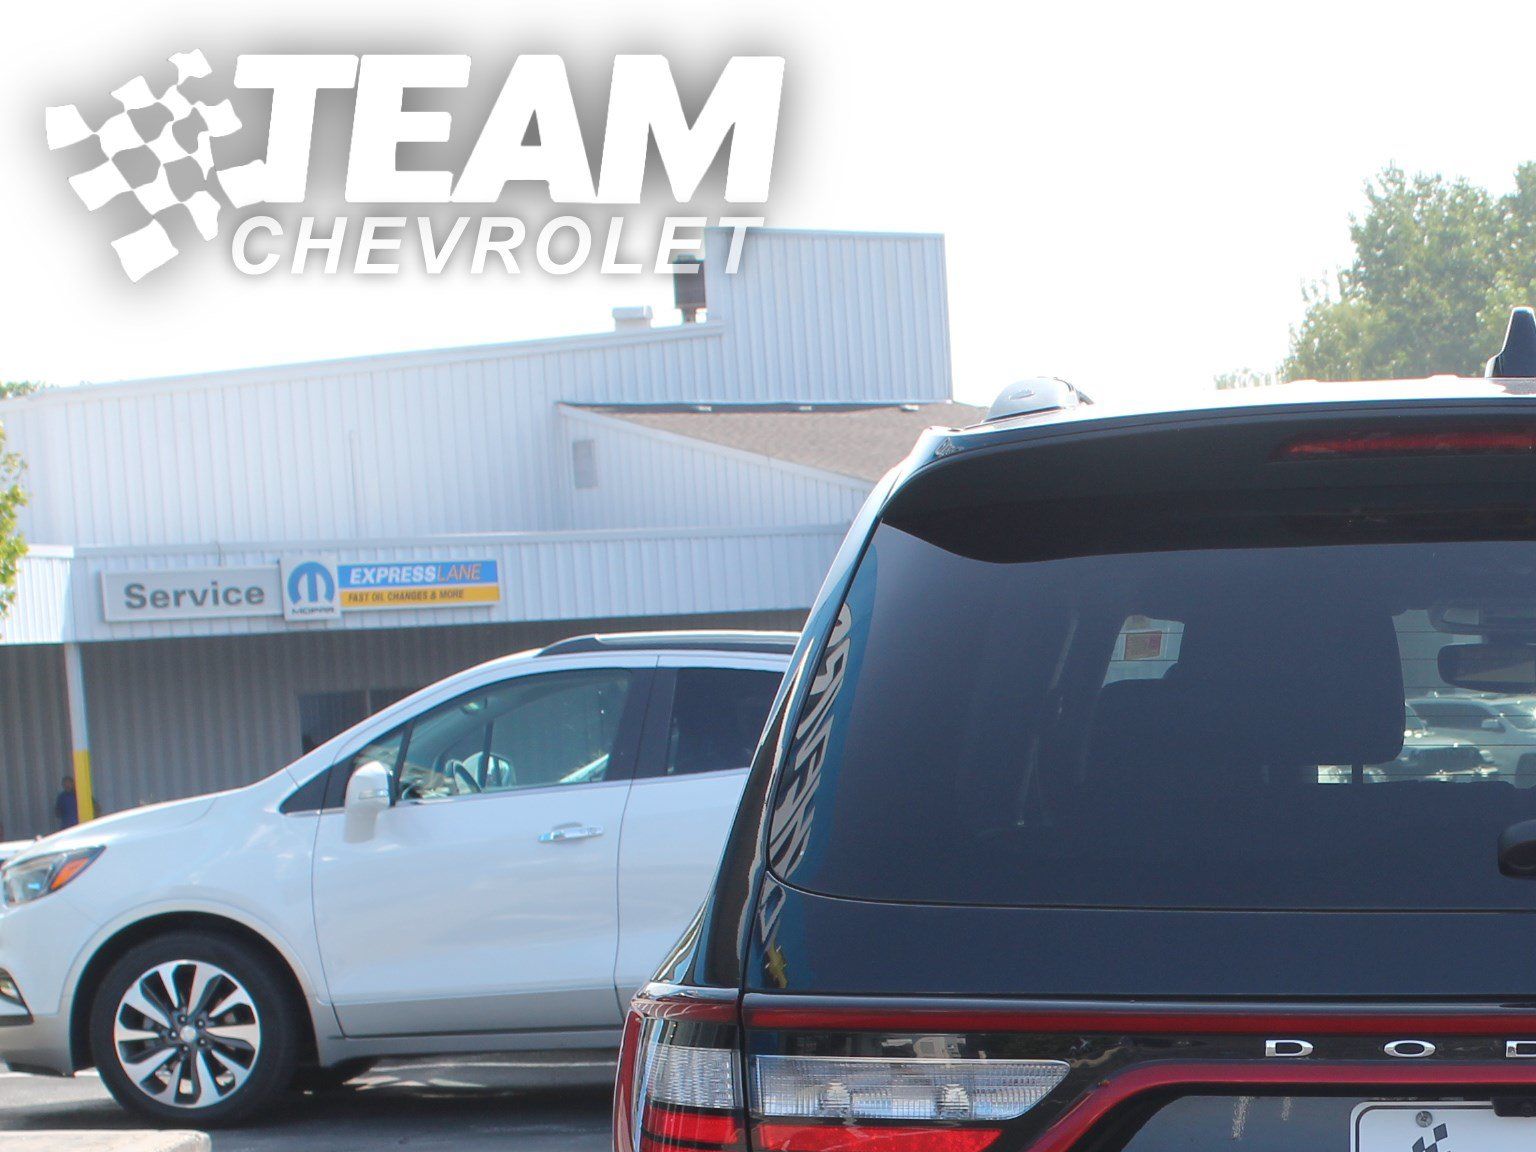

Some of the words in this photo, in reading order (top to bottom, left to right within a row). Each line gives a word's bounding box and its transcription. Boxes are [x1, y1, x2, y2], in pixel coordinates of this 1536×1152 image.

[123, 579, 265, 610] Service
[348, 591, 369, 602] FAST
[371, 591, 384, 601] OIL
[387, 589, 428, 601] CHANGES
[439, 588, 464, 599] MORE
